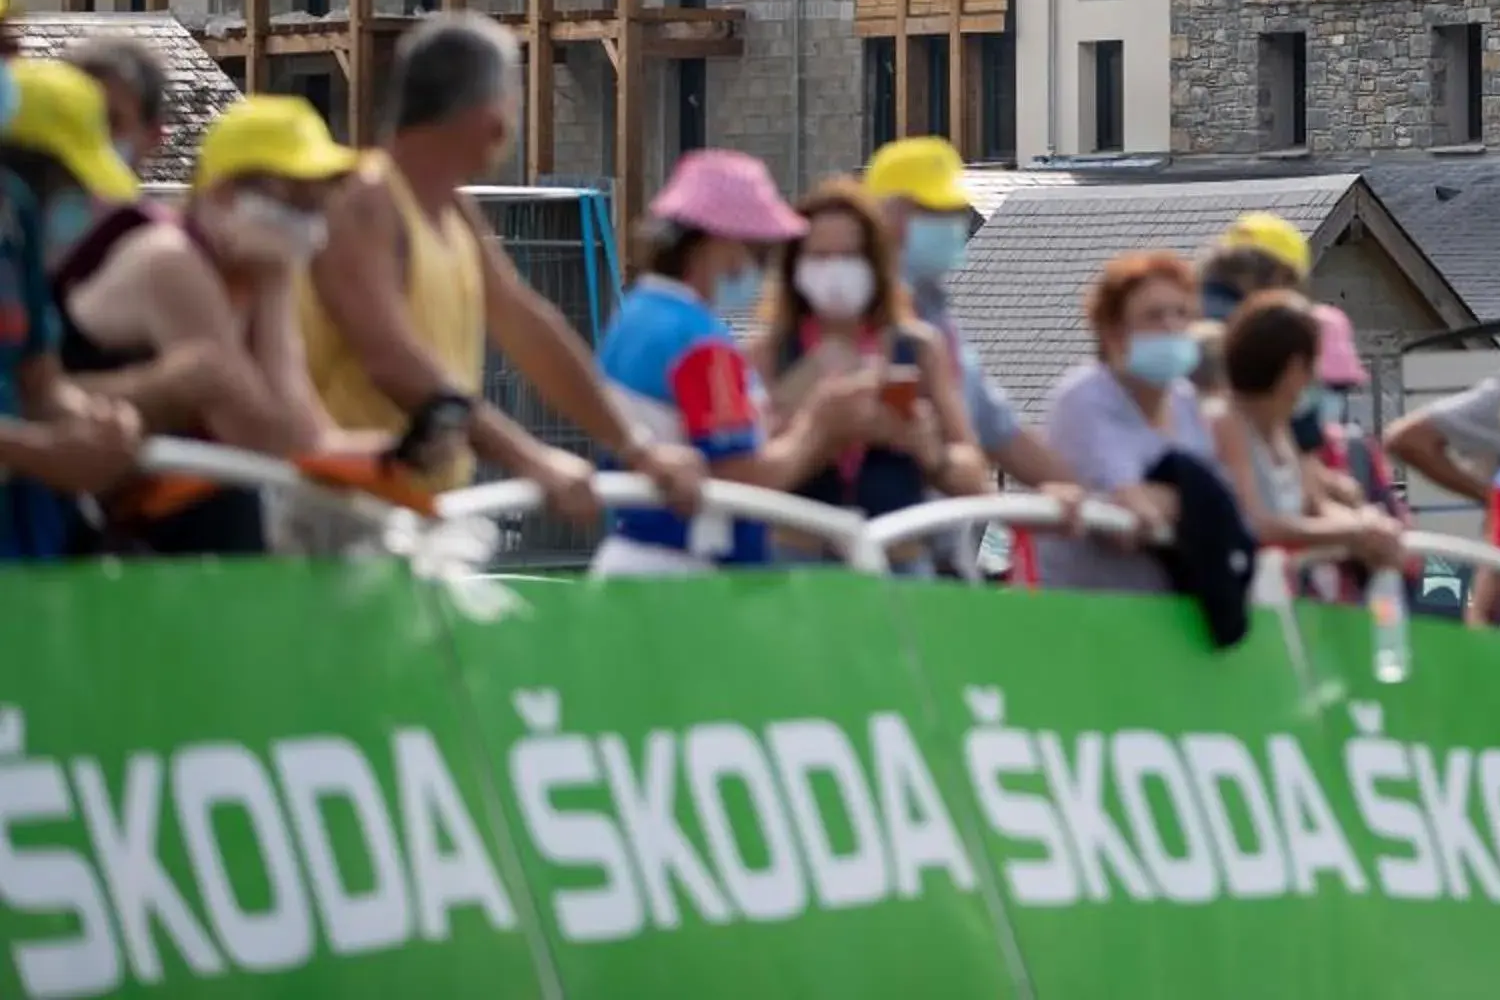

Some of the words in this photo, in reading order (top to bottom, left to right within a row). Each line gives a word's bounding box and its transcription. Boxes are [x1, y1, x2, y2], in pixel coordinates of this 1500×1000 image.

[0, 702, 518, 1000] ŠKODA
[508, 687, 978, 943] ŠKODA
[963, 686, 1370, 907] ŠKODA
